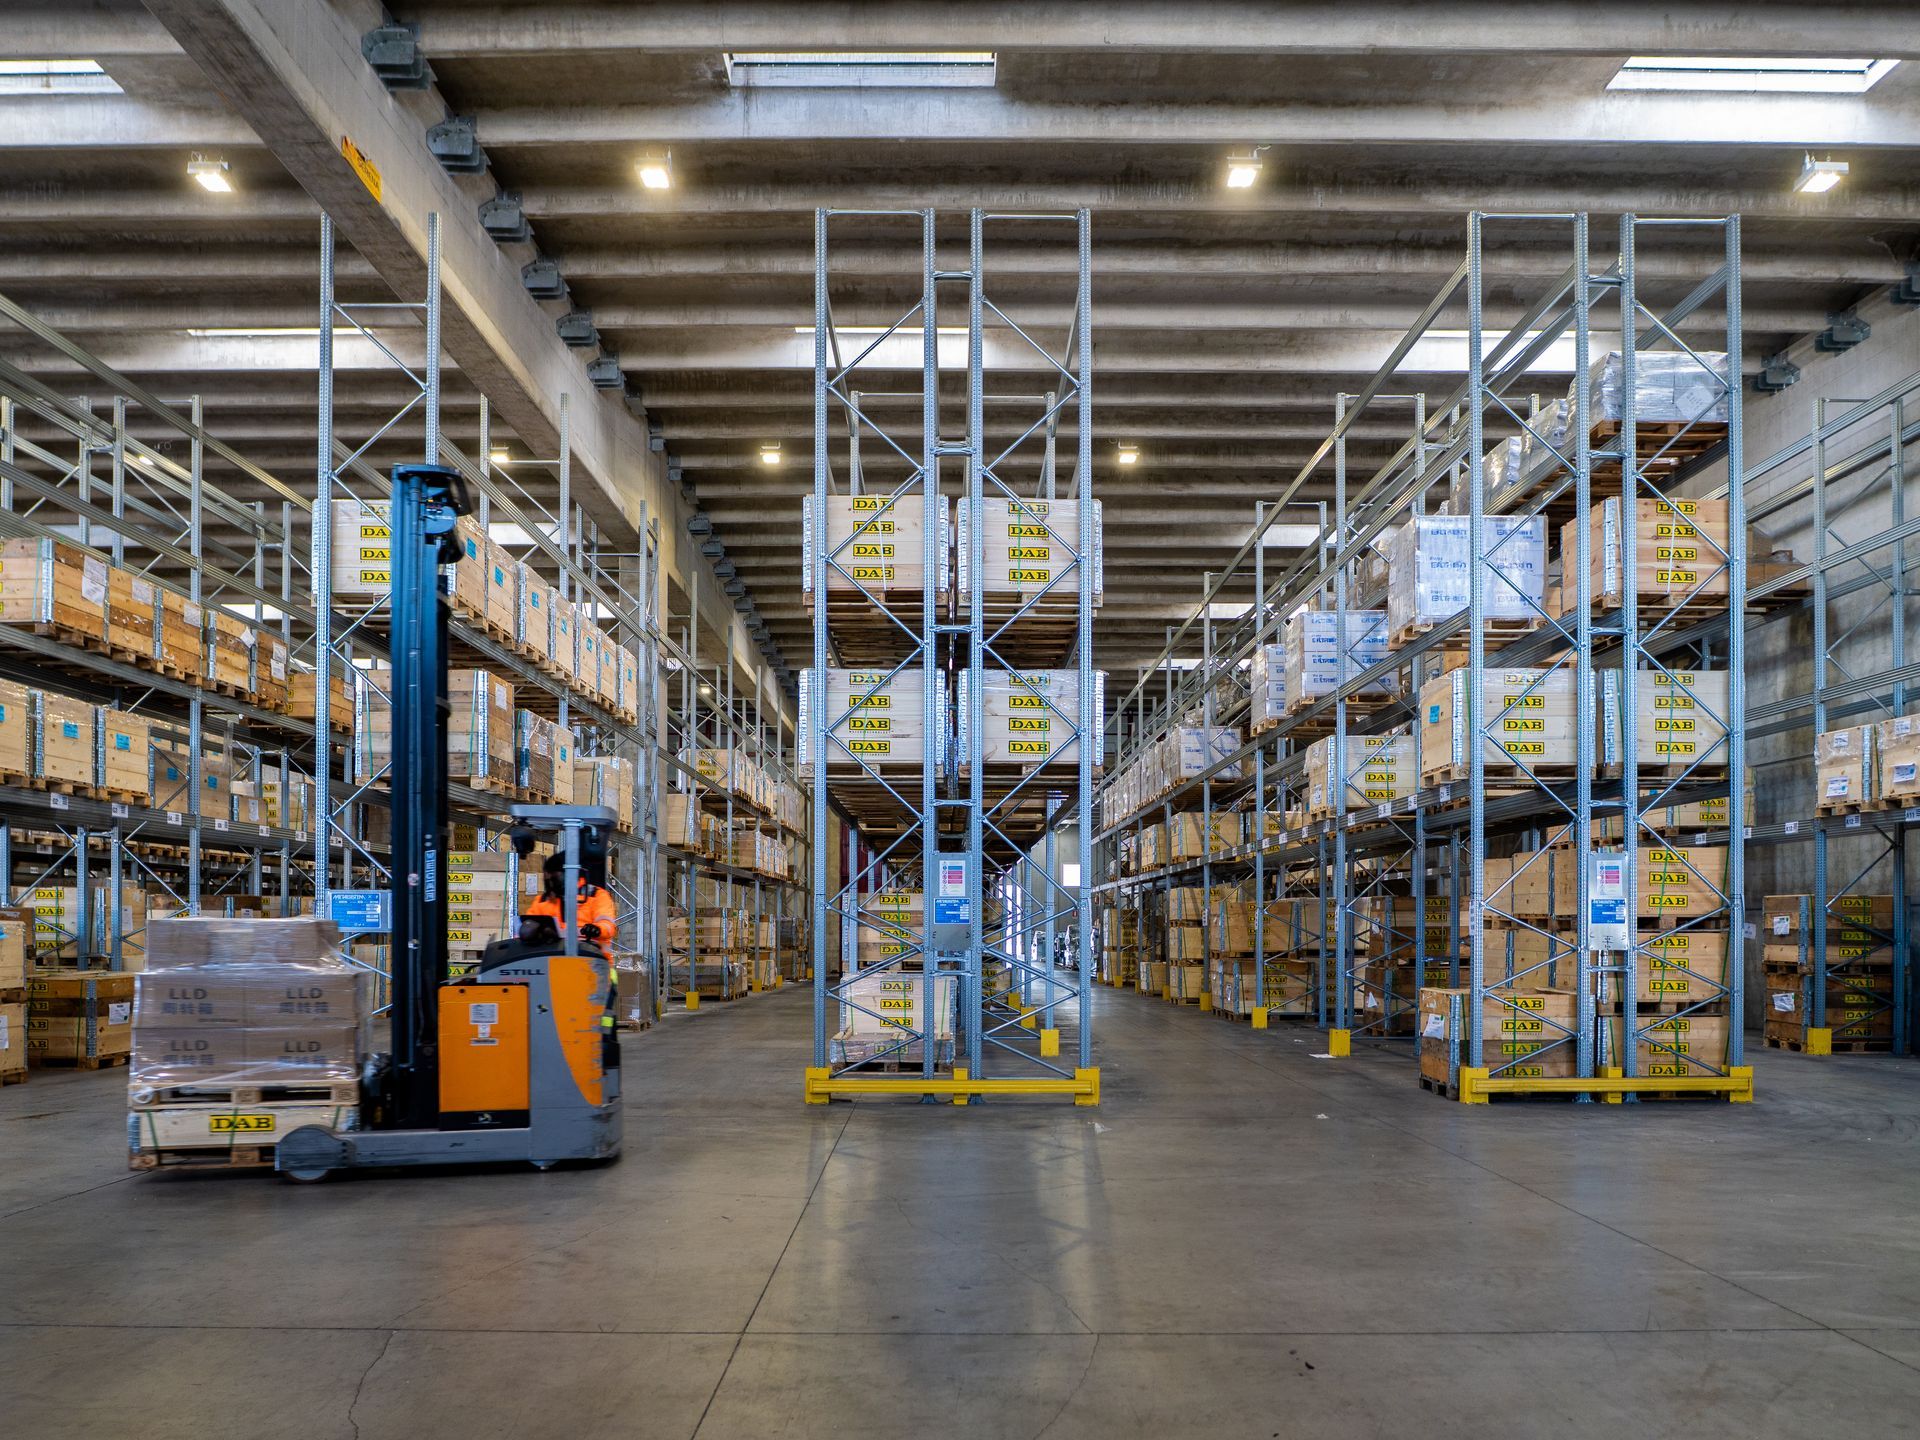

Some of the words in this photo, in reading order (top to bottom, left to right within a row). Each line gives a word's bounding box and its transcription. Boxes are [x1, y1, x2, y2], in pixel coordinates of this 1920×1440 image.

[1010, 503, 1047, 513] DAB
[363, 528, 390, 536] DA
[1010, 526, 1047, 535] DAB
[1659, 526, 1694, 535] DAB
[363, 550, 390, 558] DA
[855, 546, 892, 555] DAB
[1011, 548, 1047, 558] DAB
[1660, 549, 1694, 558] DAB
[363, 572, 390, 580] DA
[855, 569, 892, 578] DAB
[1011, 571, 1047, 580] DAB
[1659, 572, 1694, 581] DAB
[851, 697, 888, 706] DAB
[1011, 698, 1048, 706] DAB
[1506, 698, 1542, 706] DAB
[1657, 698, 1692, 707] DAB
[851, 720, 888, 728] DAB
[1011, 720, 1048, 729] DAB
[1506, 720, 1542, 729] DAB
[1658, 720, 1693, 729] DAB
[851, 742, 888, 751] DAB
[1011, 743, 1048, 752] DAB
[1506, 743, 1542, 752] DAB
[1658, 744, 1693, 753] DAB
[1651, 852, 1686, 861] DAB
[1651, 873, 1686, 883] DAB
[1650, 897, 1685, 906] DAB
[448, 913, 470, 921] AB
[1652, 938, 1686, 947] DAB
[1652, 959, 1686, 969] DAB
[1651, 982, 1686, 991] DAB
[169, 988, 208, 1000] LLD
[286, 988, 323, 1000] LLD
[1506, 1000, 1542, 1008] DAB
[1504, 1021, 1540, 1030] DAB
[1652, 1021, 1688, 1030] DAB
[170, 1040, 208, 1051] LLD
[284, 1040, 322, 1053] LLD
[1651, 1066, 1686, 1075] DAB
[213, 1117, 272, 1130] DAB
